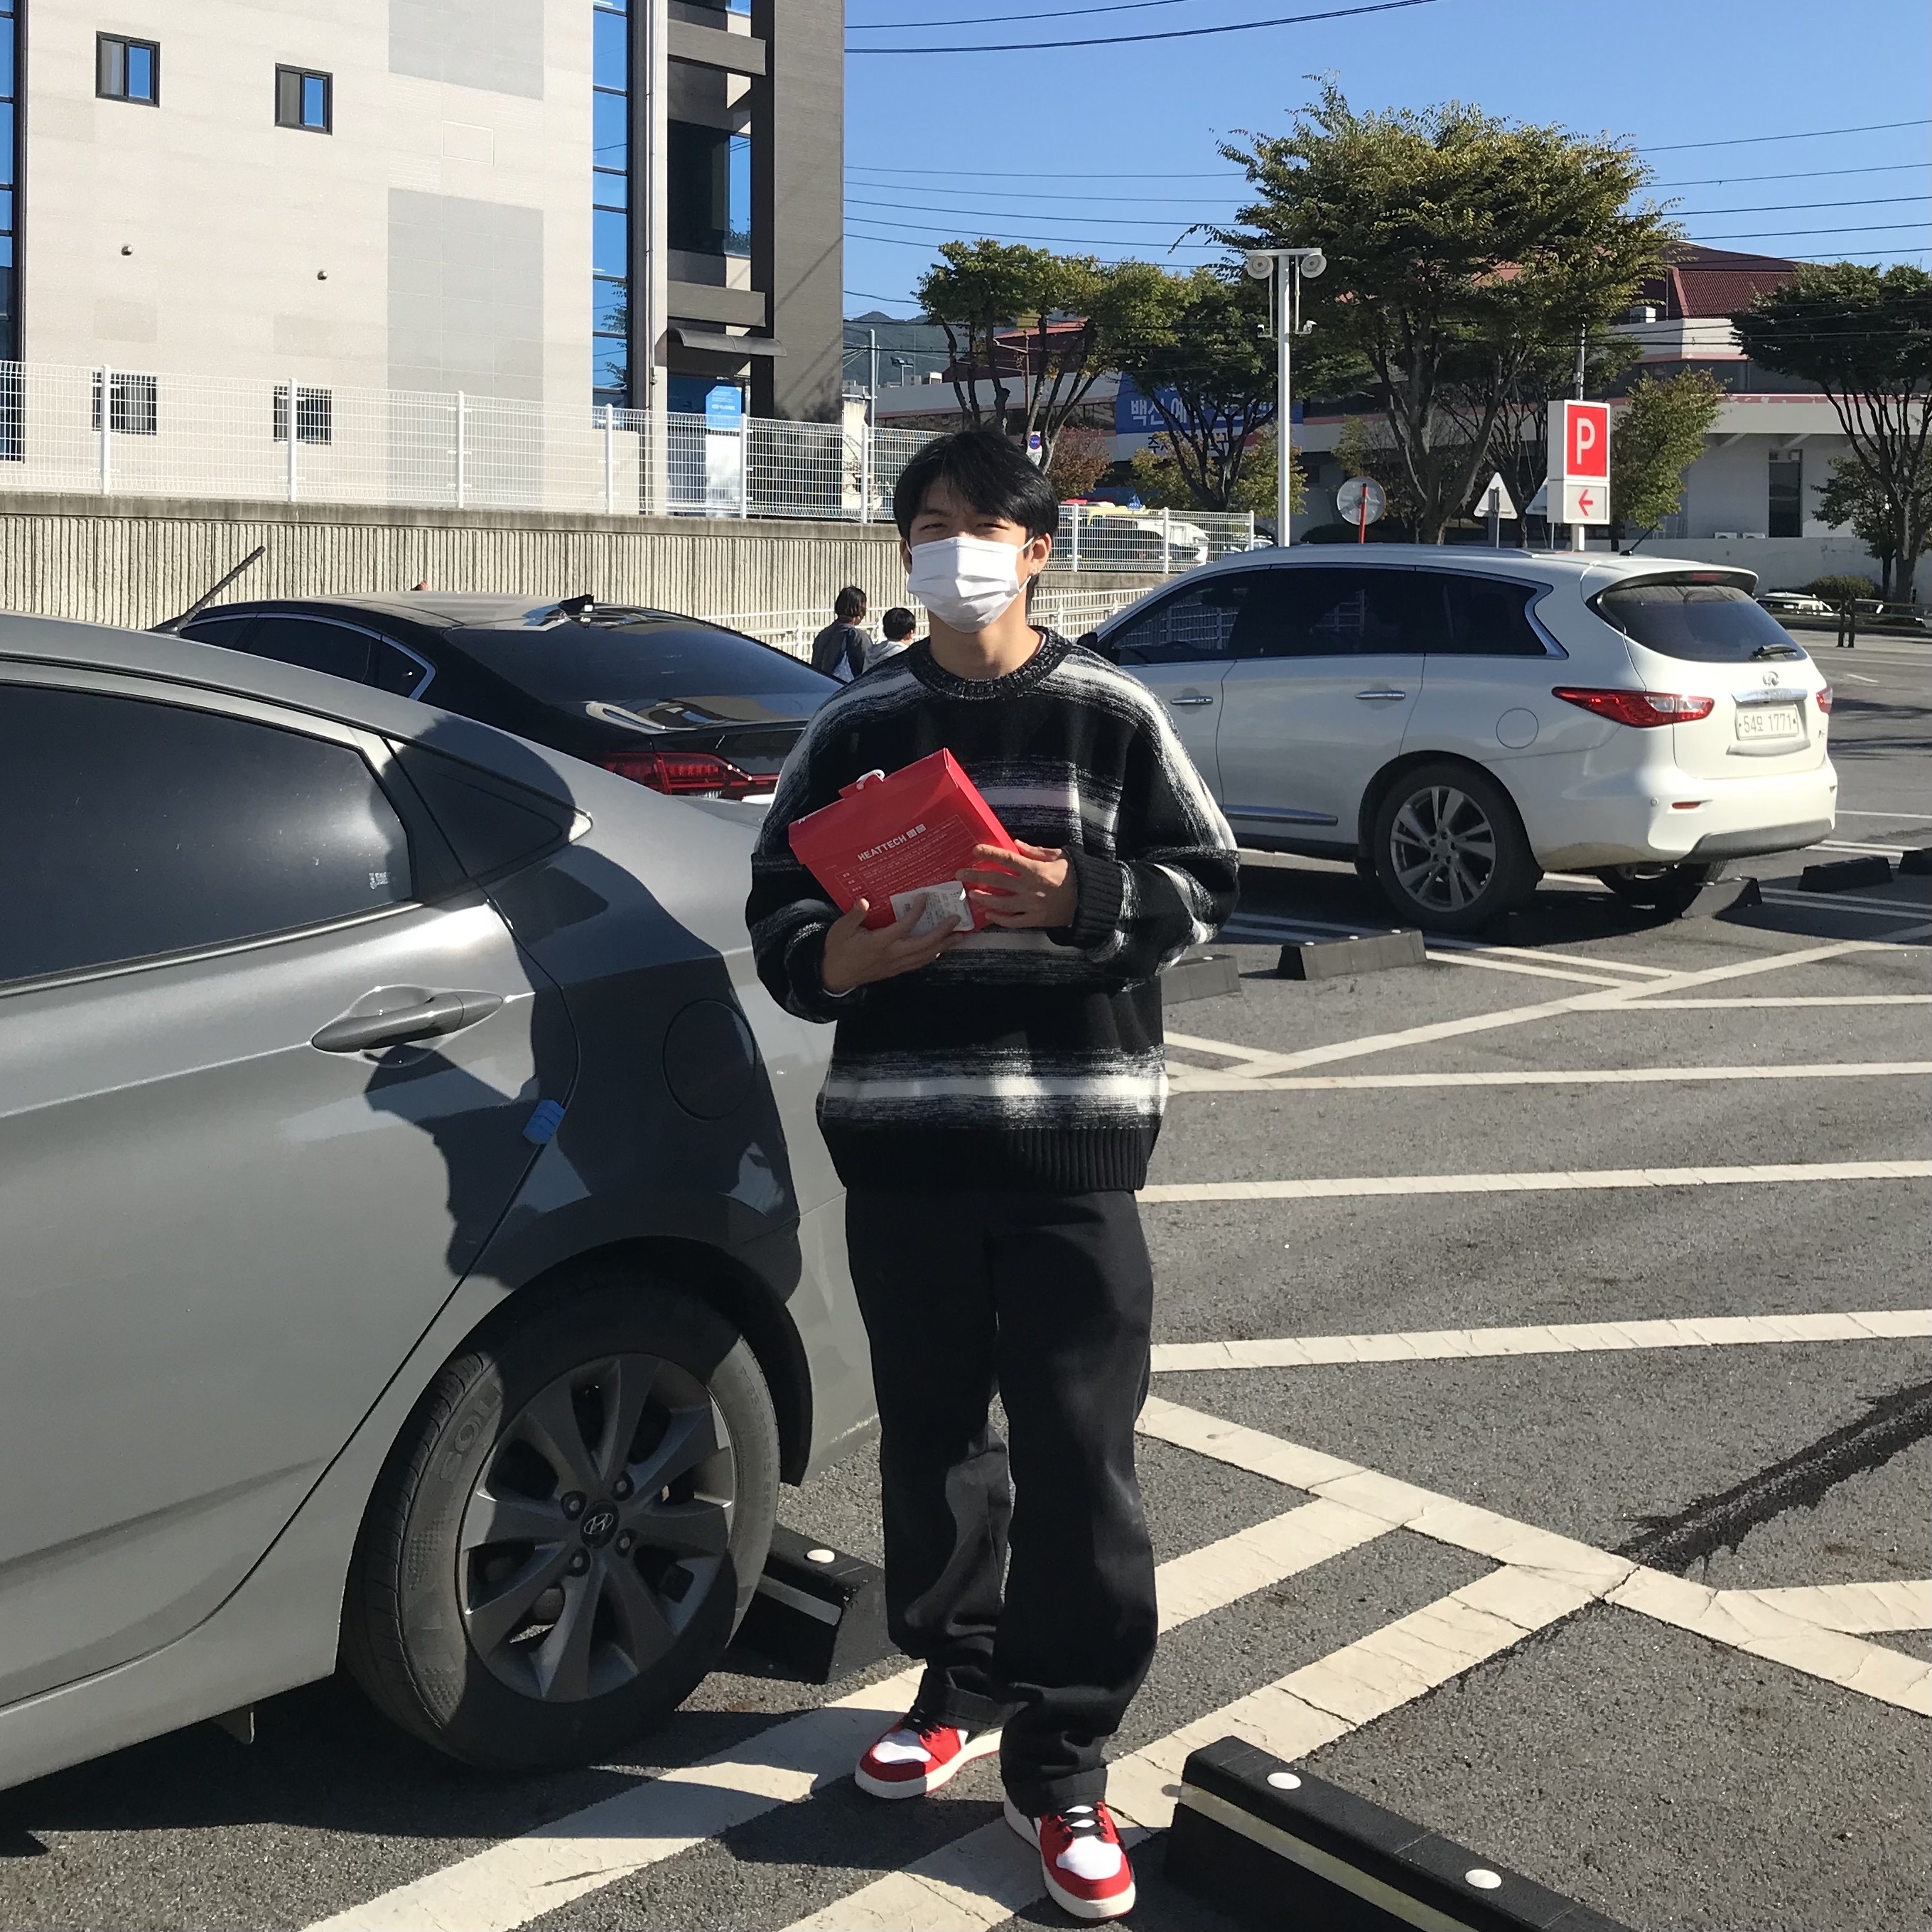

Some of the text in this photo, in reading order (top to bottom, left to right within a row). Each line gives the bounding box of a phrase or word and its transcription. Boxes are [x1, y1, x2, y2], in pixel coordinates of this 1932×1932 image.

[1576, 417, 1596, 465] P
[1768, 713, 1792, 732] 1771
[857, 833, 907, 862] HEATTECH
